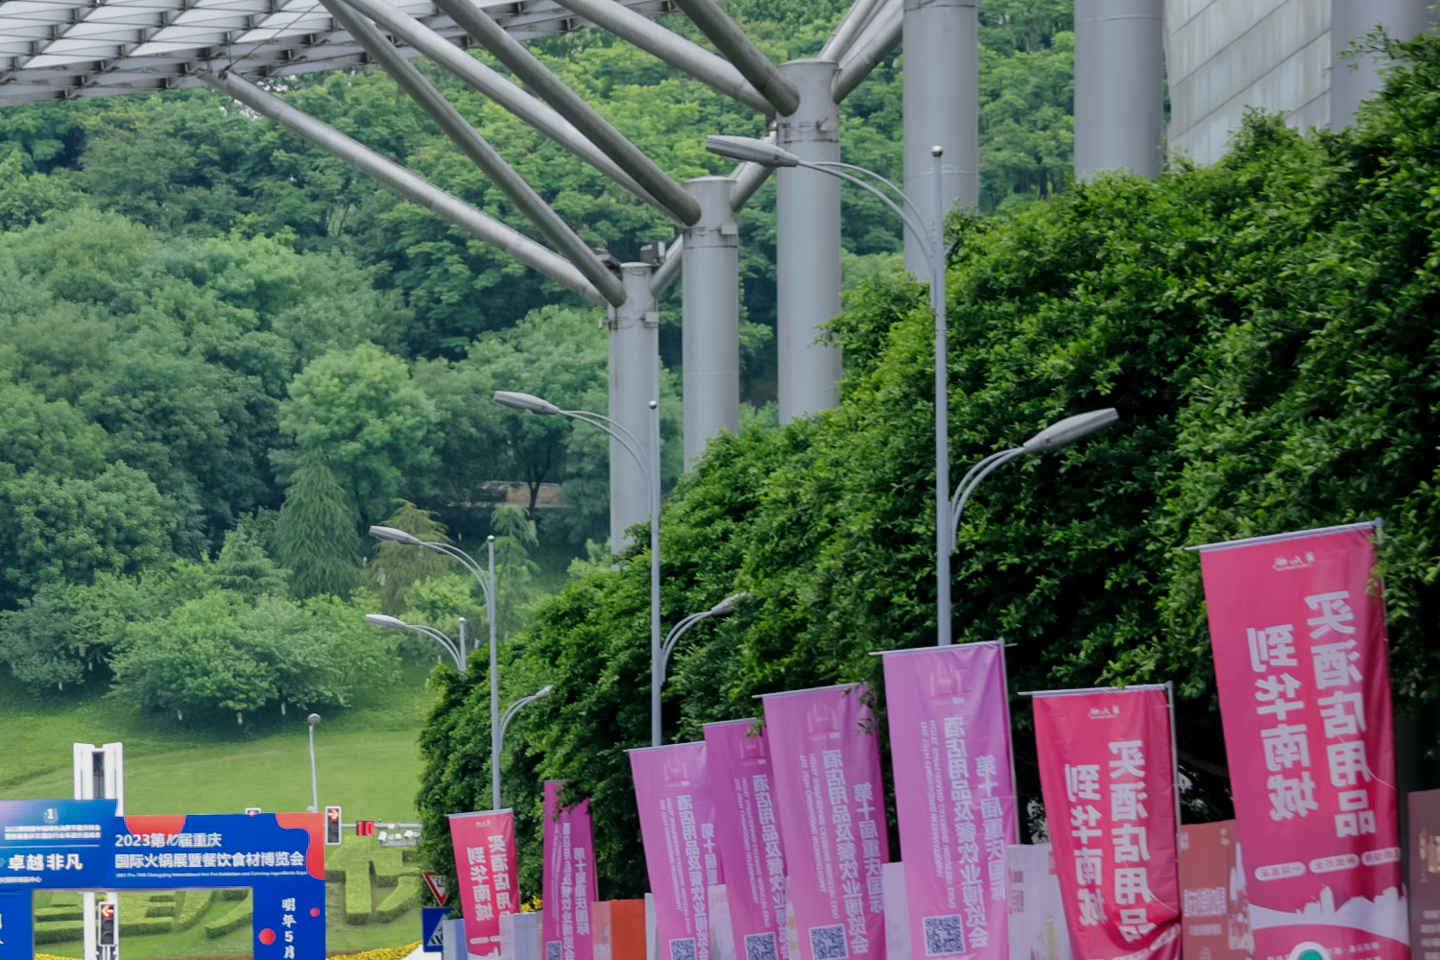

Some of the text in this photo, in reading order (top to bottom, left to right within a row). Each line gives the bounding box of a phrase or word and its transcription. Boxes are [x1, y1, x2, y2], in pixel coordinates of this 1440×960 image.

[115, 833, 222, 848] 2023第10届重庆
[7, 853, 83, 871] 卓越非凡
[115, 851, 305, 869] 国际火锅展暨餐饮食材博览会
